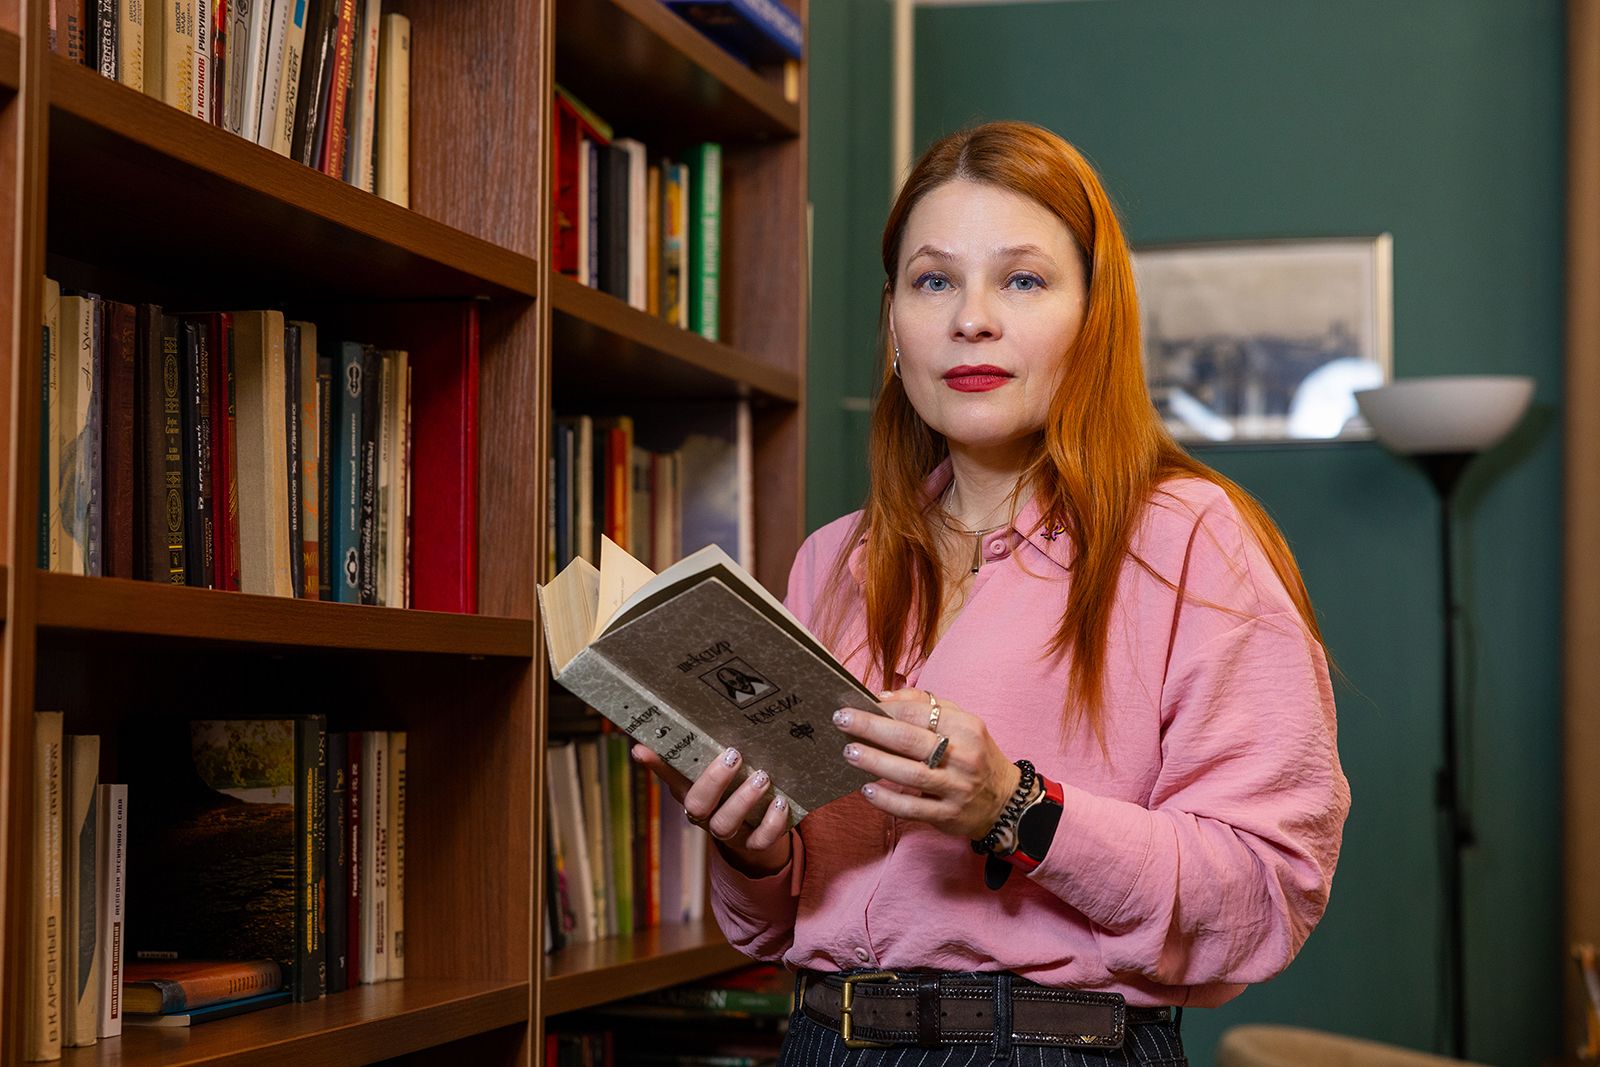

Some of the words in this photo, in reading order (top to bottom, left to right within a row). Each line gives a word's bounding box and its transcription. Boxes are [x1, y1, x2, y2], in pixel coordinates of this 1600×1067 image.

[197, 0, 206, 51] РИСУНКИ
[197, 58, 205, 108] КОЗАКОВ
[290, 46, 299, 82] БЕРГ
[286, 85, 296, 143] АКСЕЛЬ
[46, 915, 57, 1008] АРСЕНЬЕВ
